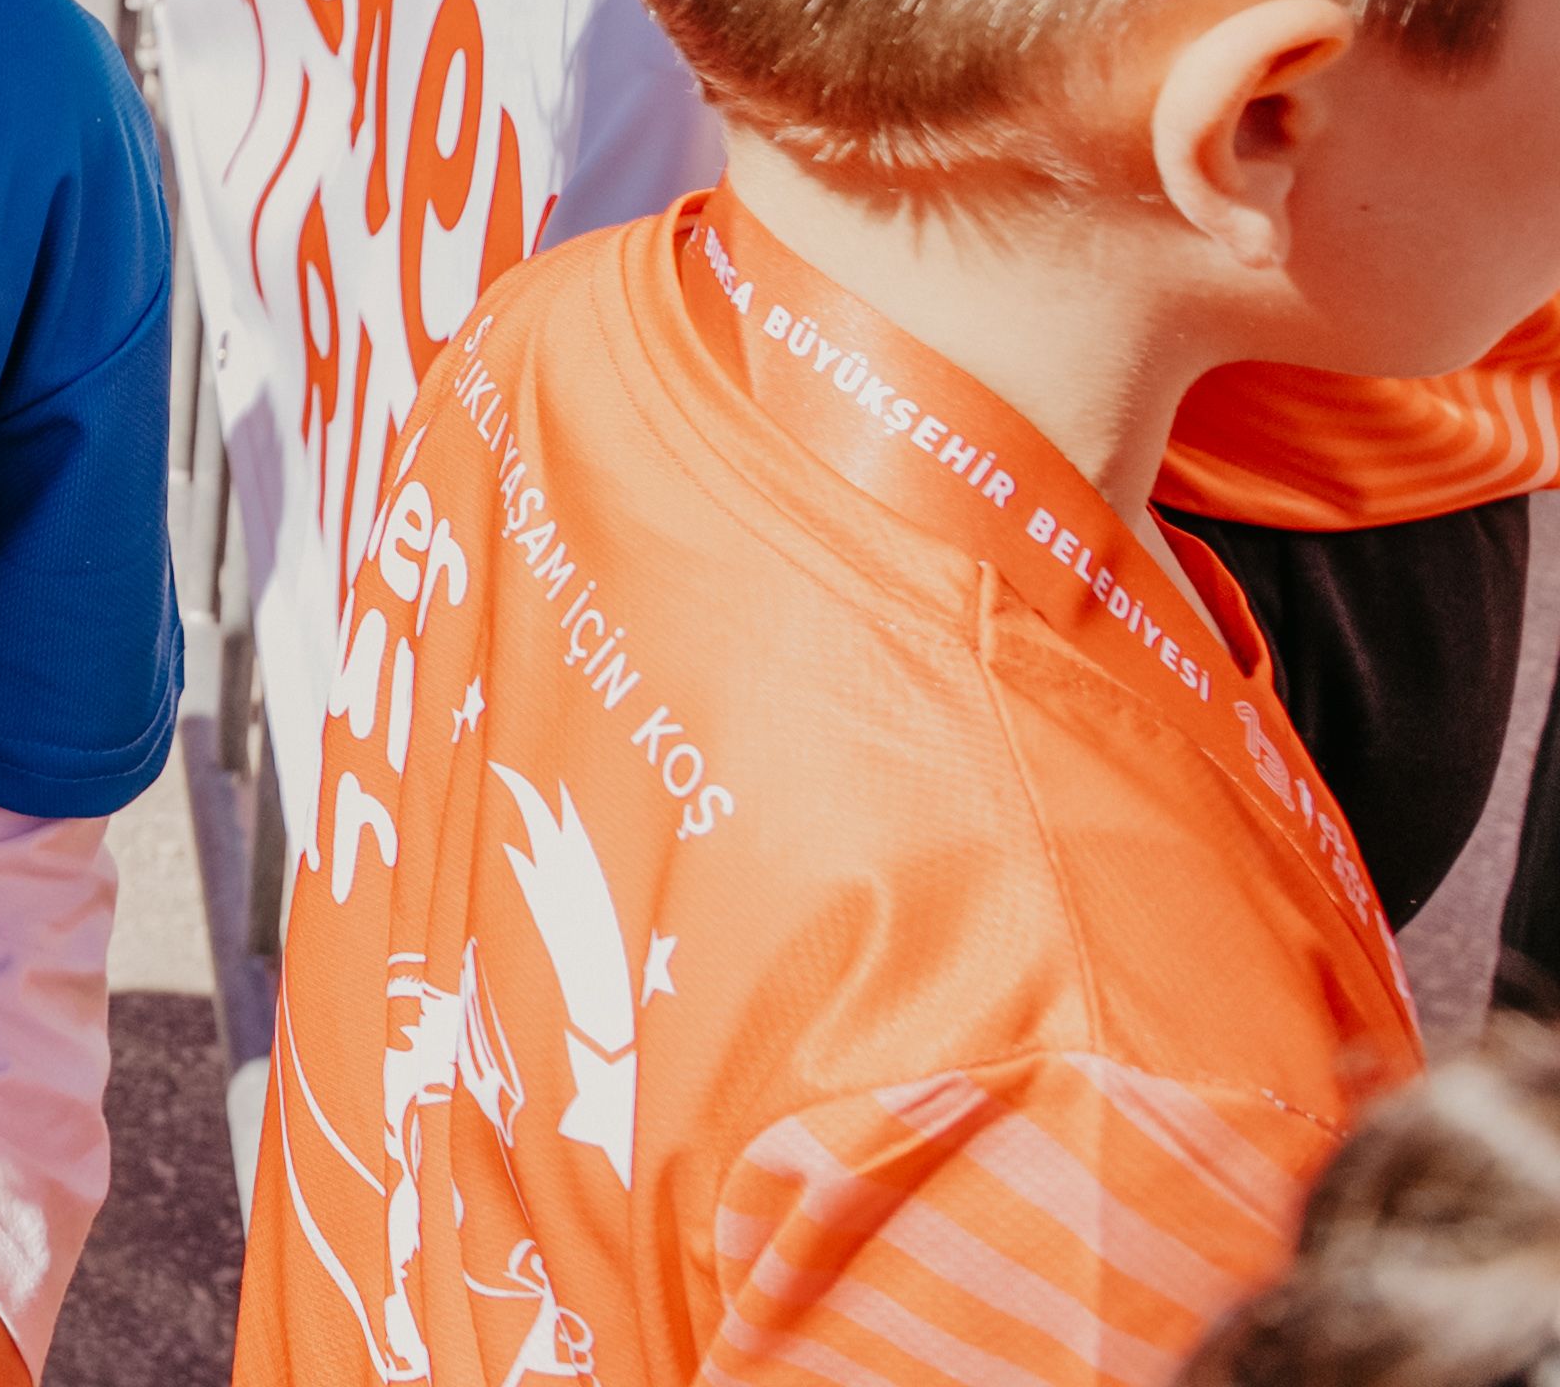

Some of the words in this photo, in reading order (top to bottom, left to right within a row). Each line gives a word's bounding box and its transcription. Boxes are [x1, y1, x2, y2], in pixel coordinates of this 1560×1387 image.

[496, 445, 577, 603] YAŞAM
[560, 579, 642, 712] İÇİN
[630, 705, 735, 841] KOŞ
[762, 303, 1017, 509] BÜYÜKŞEHİR
[1024, 506, 1212, 704] BELEDİYESİ
